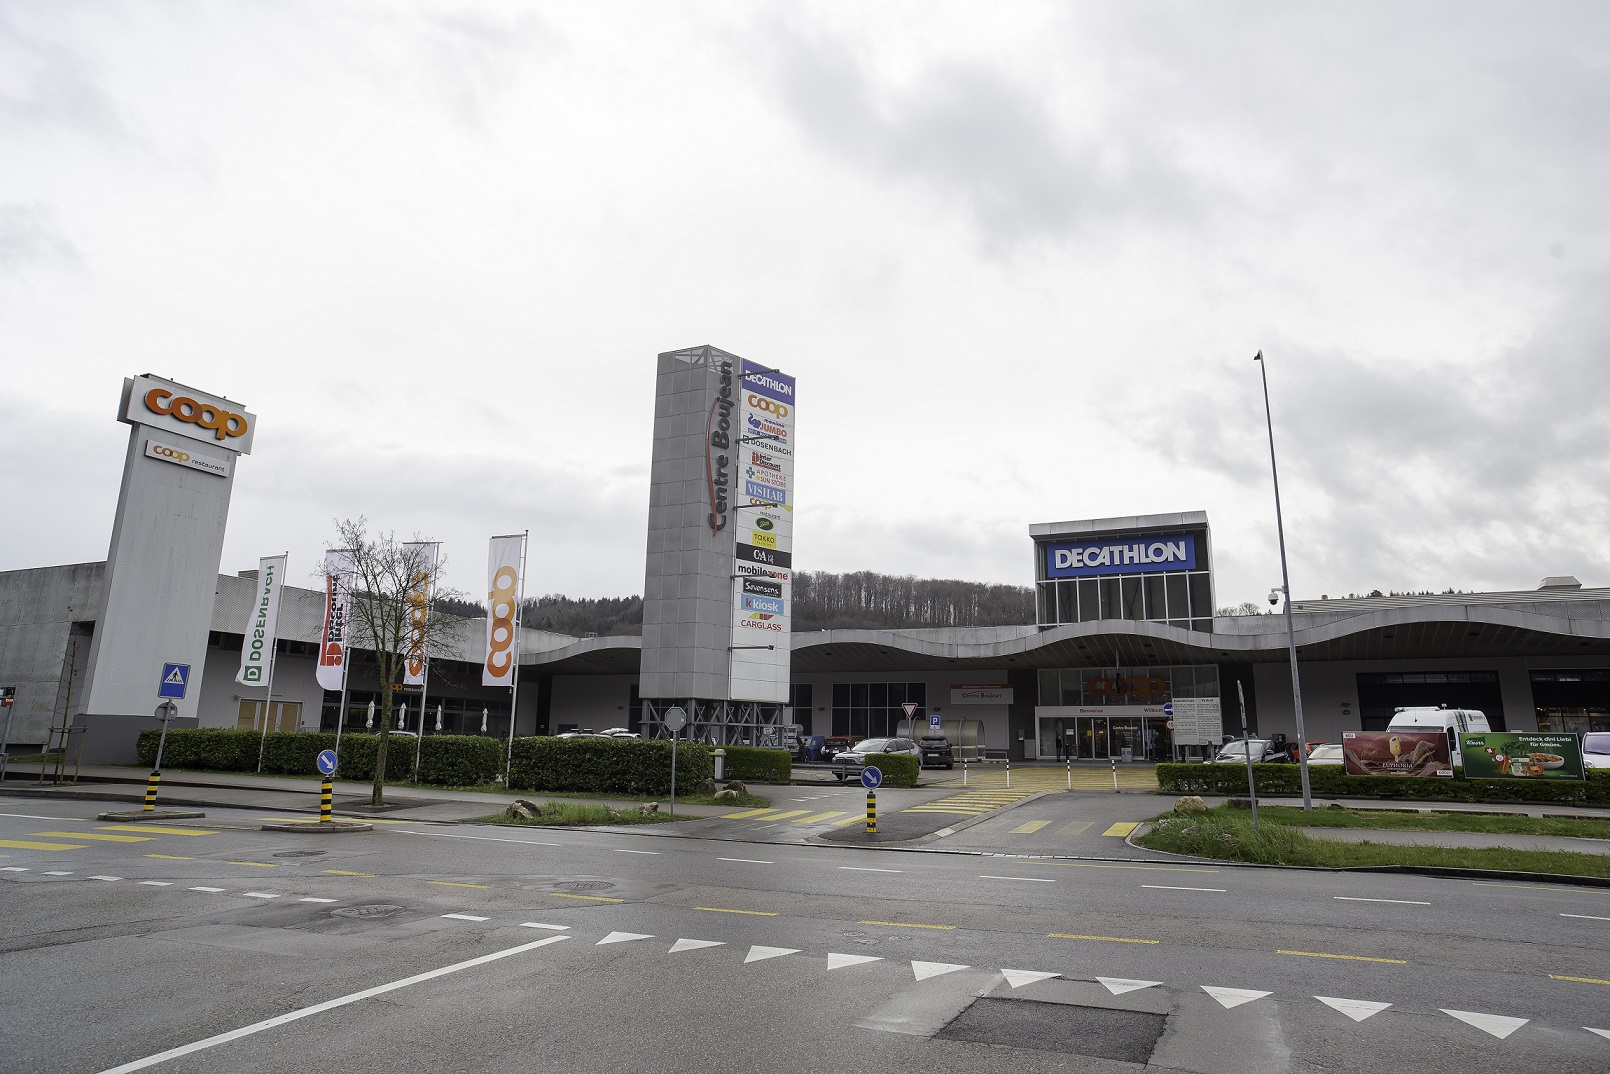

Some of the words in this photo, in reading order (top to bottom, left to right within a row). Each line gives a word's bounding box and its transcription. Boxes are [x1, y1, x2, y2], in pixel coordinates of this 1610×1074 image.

[745, 370, 792, 396] DECATHLON
[145, 388, 248, 440] coop
[712, 360, 736, 450] Boujean
[748, 394, 788, 419] coop
[760, 423, 787, 437] JUMBO
[750, 440, 792, 456] DOSENBACH
[153, 445, 190, 462] coop
[192, 459, 225, 472] restaurant
[760, 460, 781, 470] Discount
[756, 469, 786, 481] APOTHEKE
[771, 480, 786, 488] STORE
[708, 454, 728, 531] Centre
[748, 484, 782, 502] VISILAB
[1055, 541, 1186, 568] DECATHLON
[746, 598, 752, 608] k
[753, 599, 778, 612] kiosk
[741, 620, 781, 631] CARGLASS
[1087, 678, 1166, 701] coop
